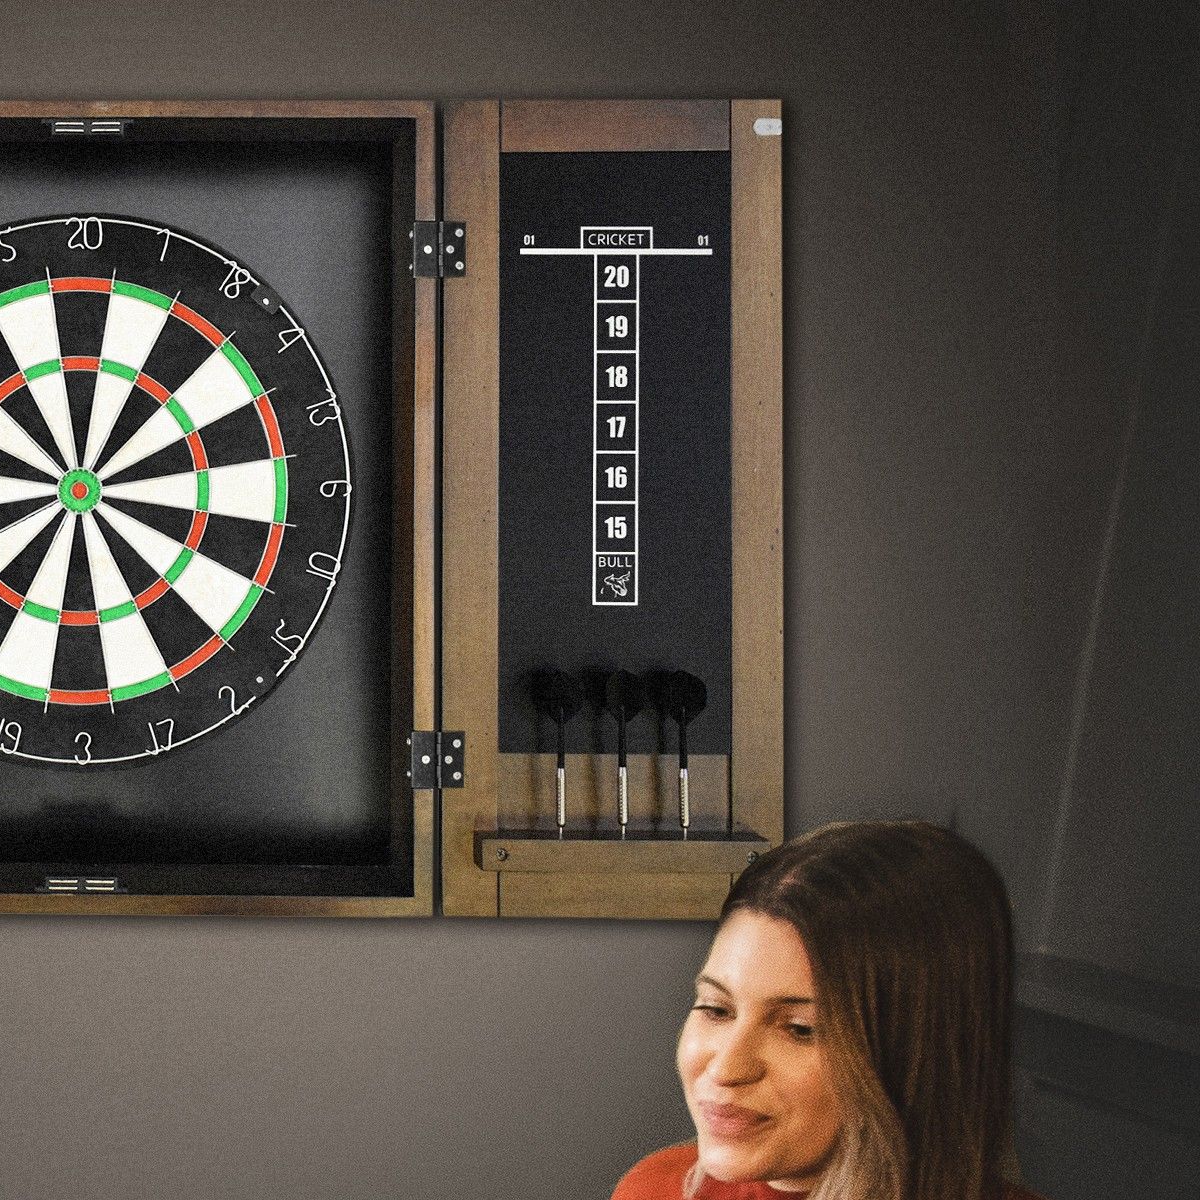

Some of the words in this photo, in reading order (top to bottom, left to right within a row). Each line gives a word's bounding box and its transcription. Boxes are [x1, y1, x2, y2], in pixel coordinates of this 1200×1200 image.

[65, 216, 103, 250] 20
[156, 228, 171, 262] 1
[523, 234, 536, 246] 01
[588, 233, 645, 246] CRICKET
[697, 234, 709, 246] 01
[218, 260, 251, 299] 18
[603, 265, 630, 289] 20
[277, 327, 305, 354] 4
[605, 315, 629, 339] 19
[605, 365, 628, 389] 18
[306, 388, 342, 426] 13
[606, 416, 627, 440] 17
[604, 465, 628, 489] 16
[603, 516, 628, 540] 15
[305, 551, 341, 591] 10
[598, 556, 633, 568] BULL
[270, 618, 305, 663] 15
[218, 685, 250, 716] 2
[73, 731, 92, 766] 3
[145, 718, 174, 756] 17
